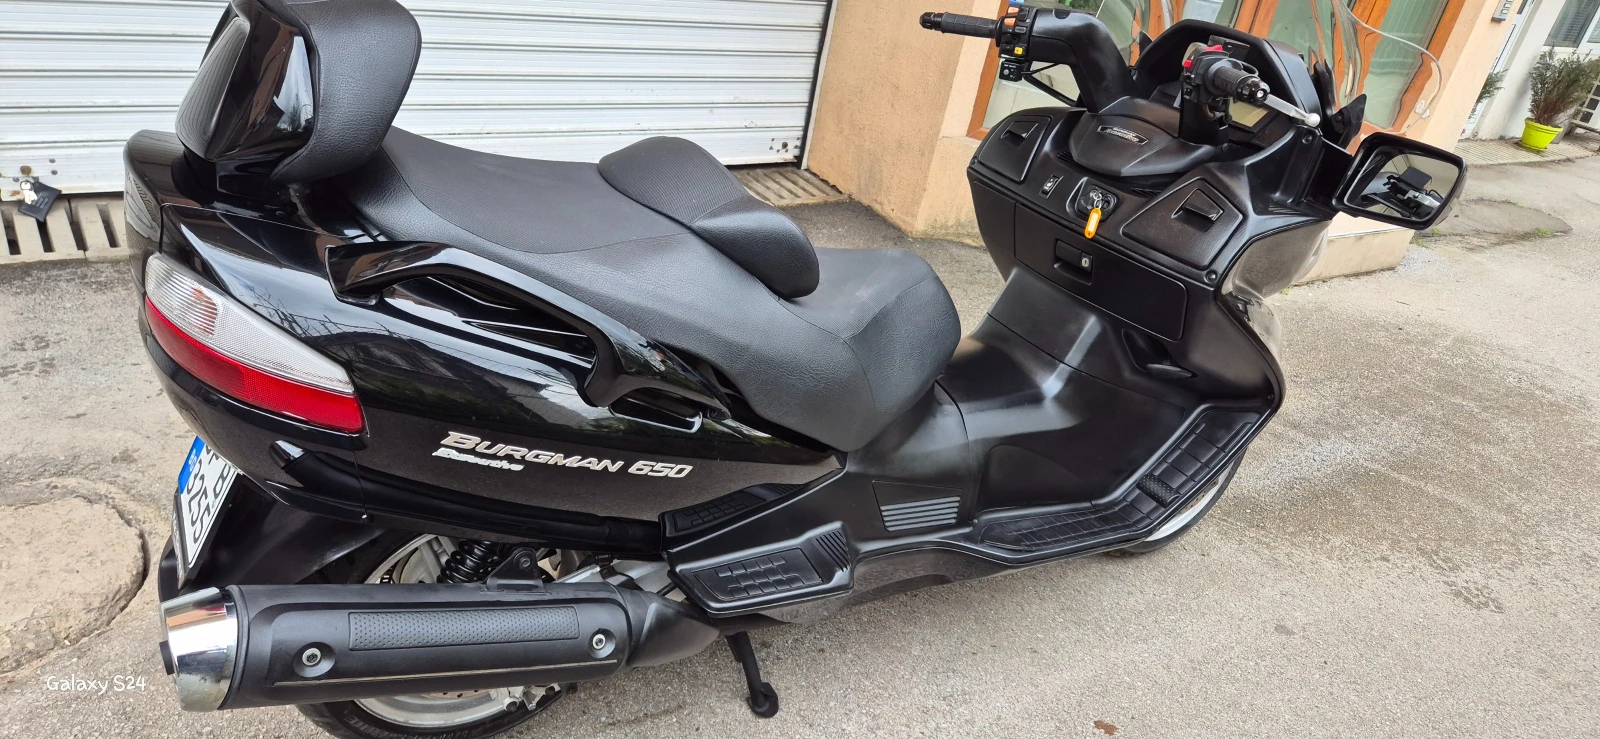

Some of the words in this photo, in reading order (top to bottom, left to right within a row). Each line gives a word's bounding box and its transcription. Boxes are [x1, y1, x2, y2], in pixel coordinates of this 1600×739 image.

[440, 431, 625, 473] BURGMAN
[628, 460, 693, 478] 650
[186, 458, 212, 544] 3255
